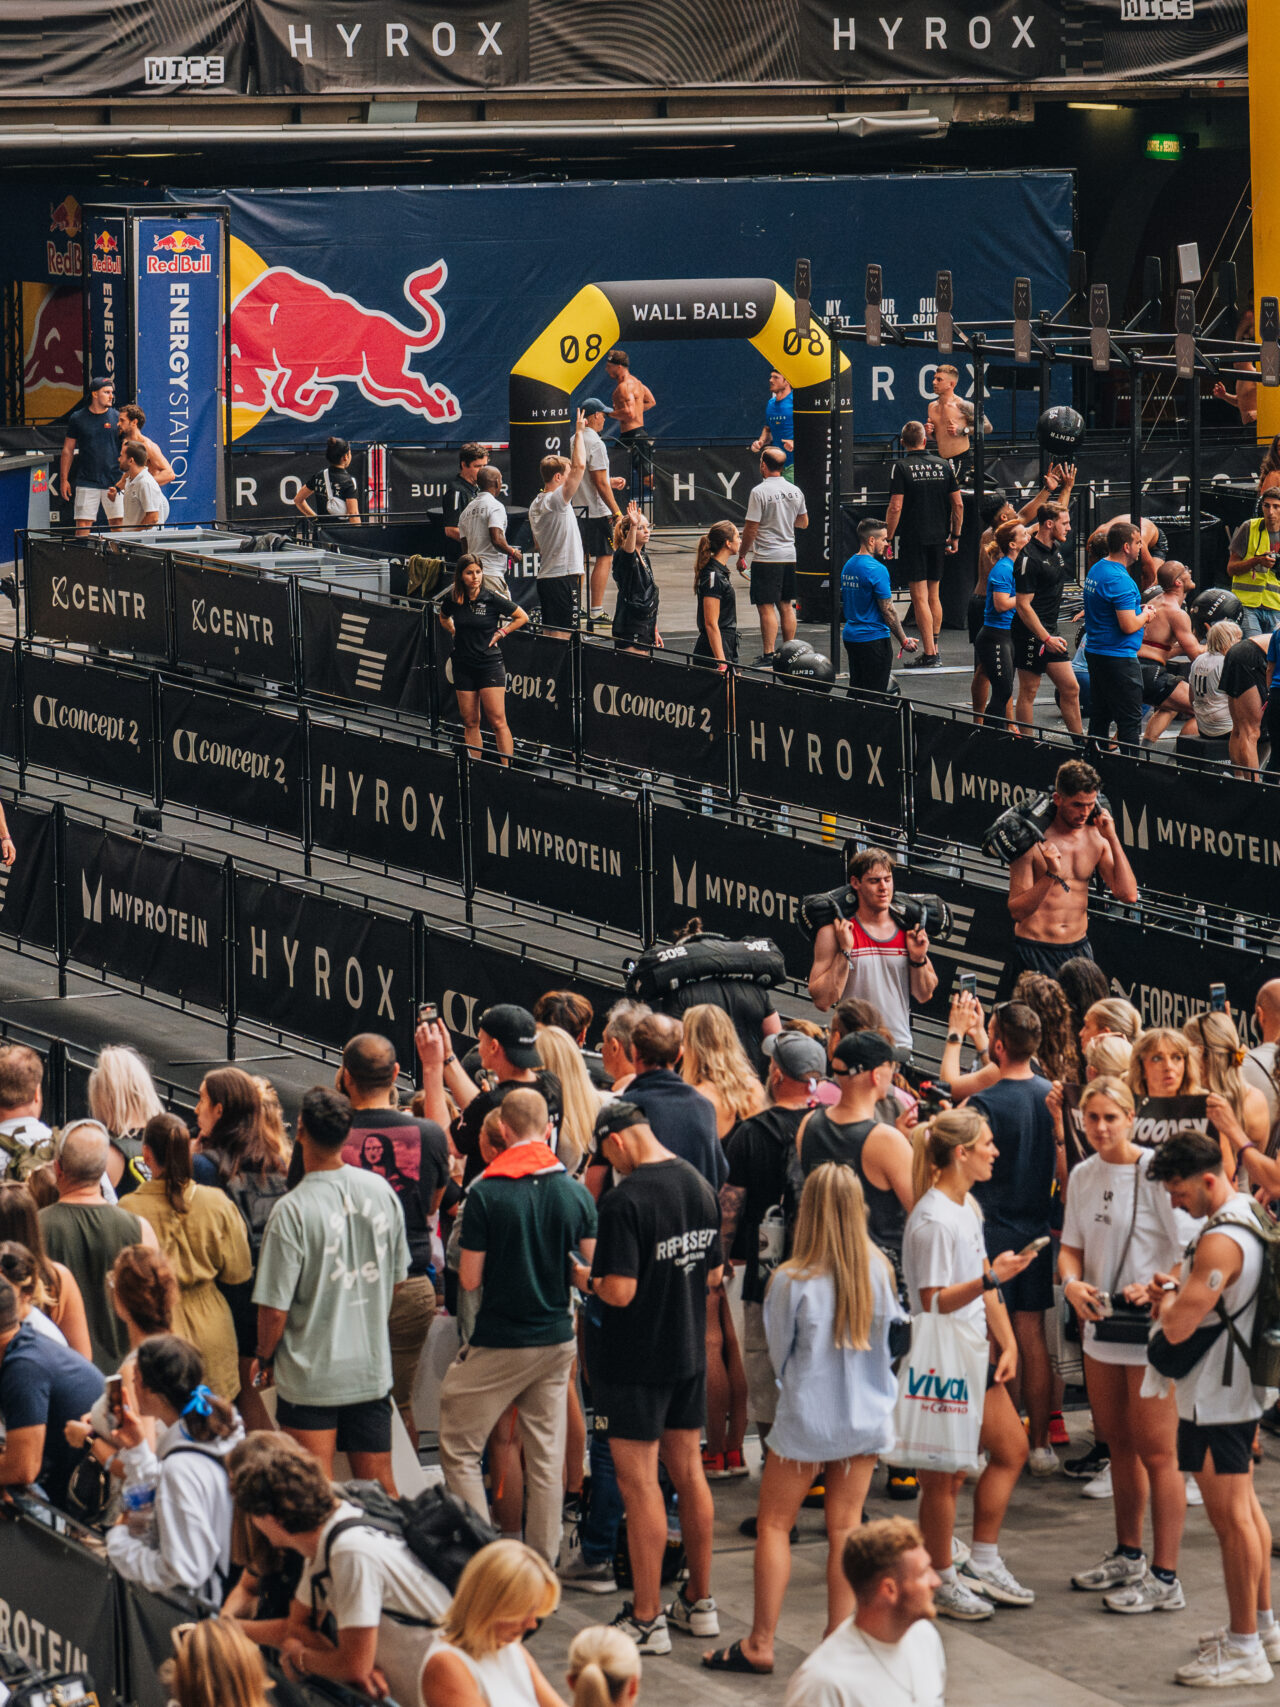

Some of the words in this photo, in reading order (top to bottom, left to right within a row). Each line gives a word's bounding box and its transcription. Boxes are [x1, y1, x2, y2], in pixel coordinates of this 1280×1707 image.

[288, 21, 503, 59] HYROX
[833, 16, 1035, 51] HYROX
[144, 56, 225, 84] NICE
[47, 241, 70, 275] Red
[92, 254, 107, 273] Red
[107, 254, 121, 274] Bull
[147, 254, 179, 273] Red
[180, 254, 211, 273] Bull
[632, 304, 686, 321] WALL
[693, 302, 757, 320] BALLS
[826, 300, 841, 315] MY
[560, 333, 602, 363] 08
[783, 327, 825, 356] 08
[532, 408, 569, 417] HYROX
[814, 398, 851, 406] HYOX
[909, 463, 932, 472] TEAM
[912, 470, 944, 478] HYROX
[72, 582, 147, 620] CENTR
[209, 606, 274, 647] CENTR
[505, 672, 542, 698] cept
[544, 678, 556, 702] 2
[59, 703, 125, 743] concept
[128, 723, 139, 746] 2
[621, 693, 695, 729] concept
[699, 707, 712, 733] 2
[199, 738, 270, 779] concept
[274, 757, 286, 785] 2
[751, 719, 885, 787] HYROX
[320, 764, 447, 840] HYROX
[517, 824, 621, 878] MYPROTEIN
[109, 887, 208, 948] MYPROTEIN
[250, 926, 395, 1021] HYROX
